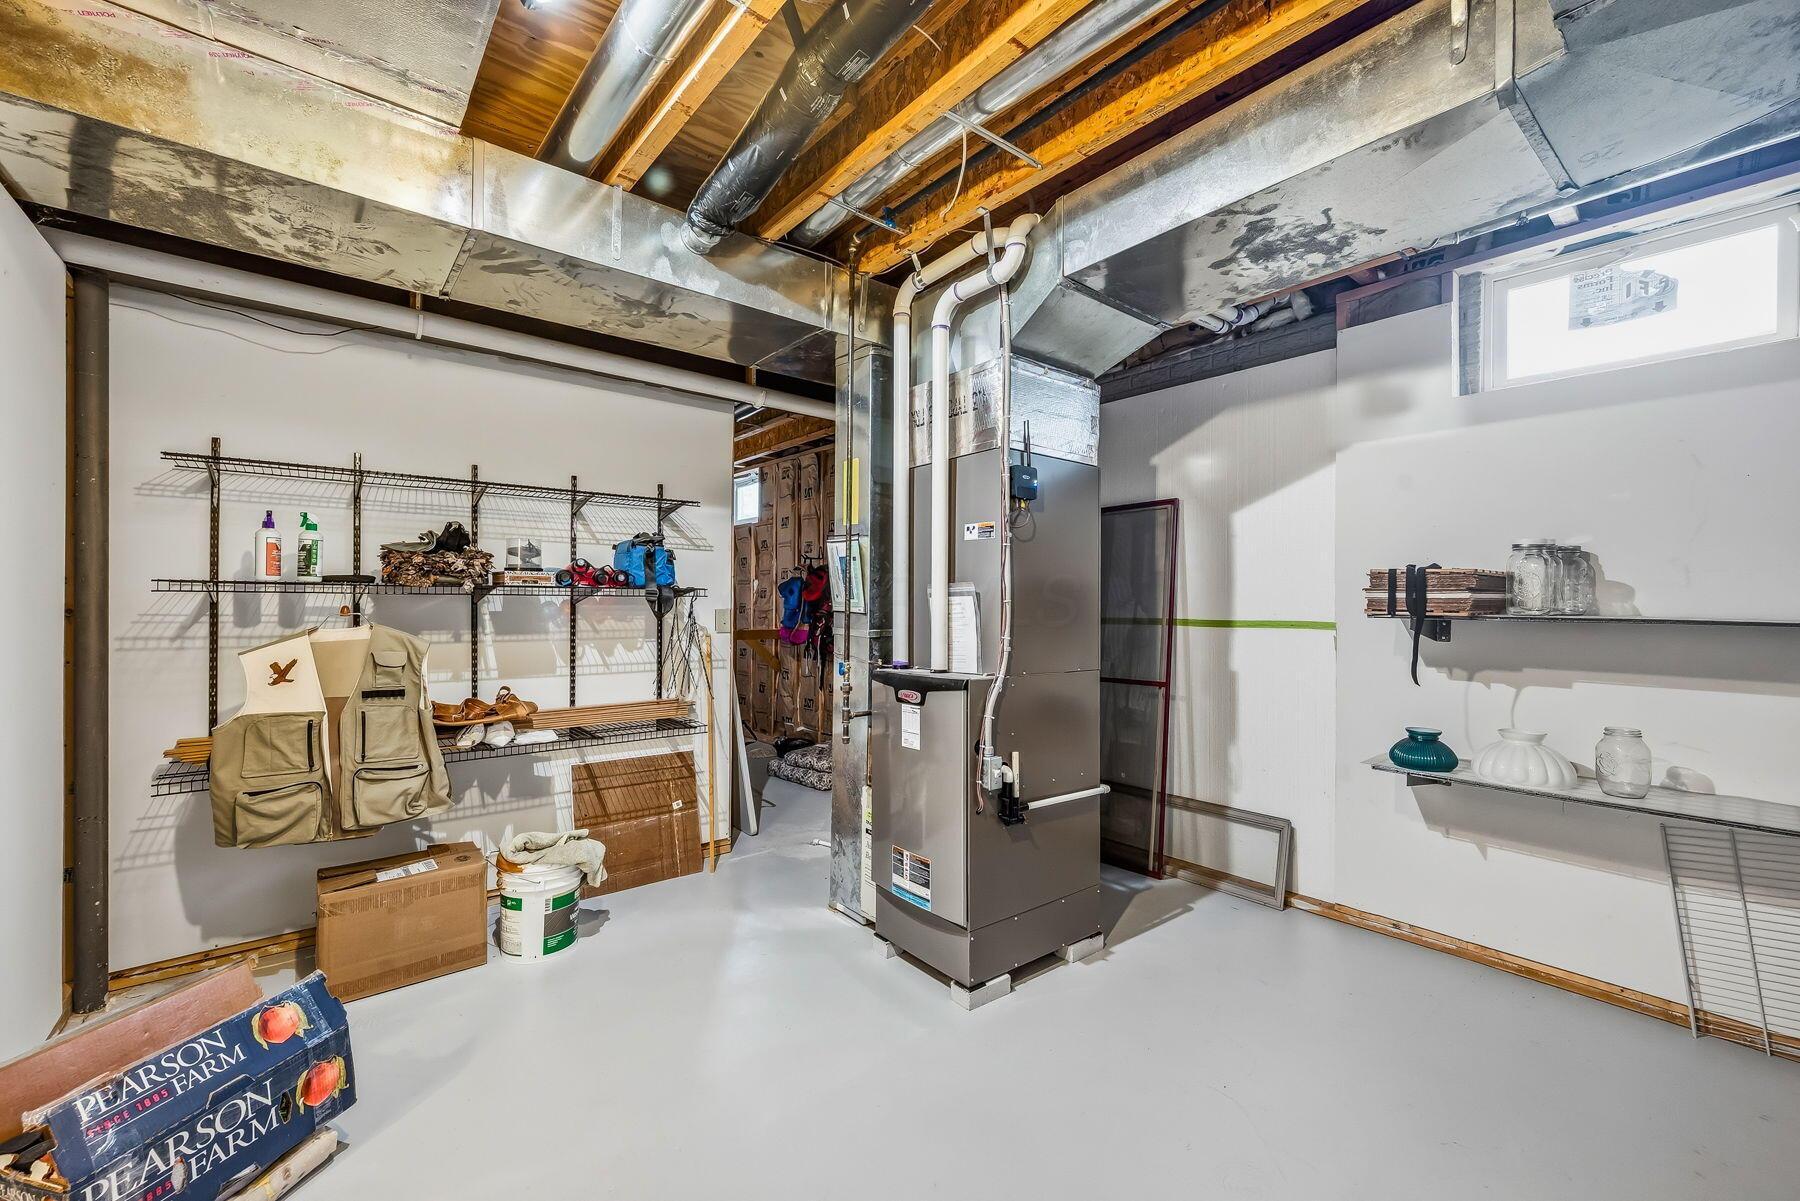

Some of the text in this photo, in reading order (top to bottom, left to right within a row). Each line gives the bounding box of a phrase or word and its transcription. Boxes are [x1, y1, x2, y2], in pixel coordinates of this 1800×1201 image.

[72, 1028, 227, 1125] PEARSON
[135, 1088, 169, 1112] 1885
[171, 1043, 247, 1096] FARM
[80, 1078, 274, 1201] PEARSON
[187, 1105, 280, 1184] FARM
